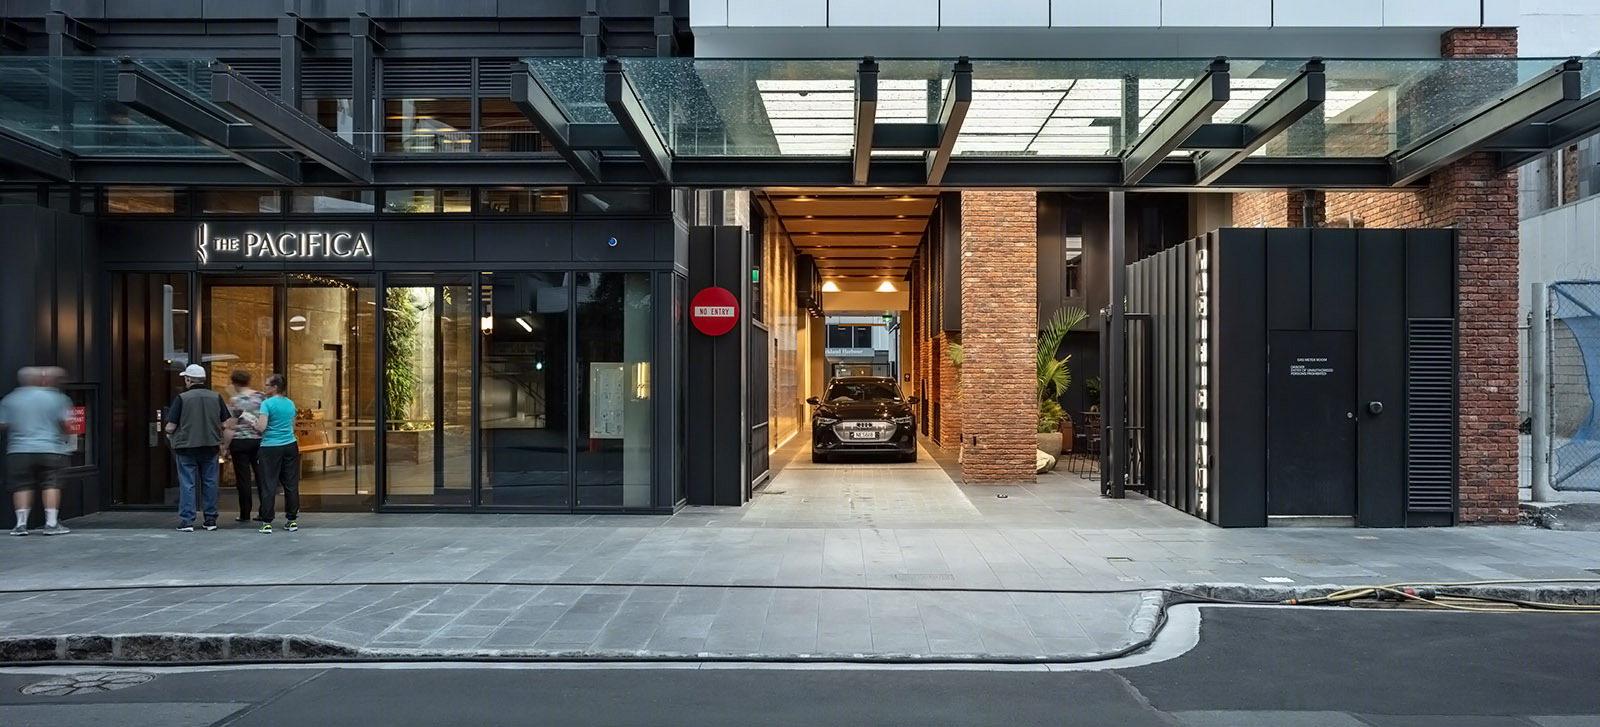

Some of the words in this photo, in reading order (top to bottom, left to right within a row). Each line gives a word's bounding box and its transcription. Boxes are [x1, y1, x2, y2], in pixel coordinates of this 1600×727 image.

[212, 237, 239, 251] THE
[244, 232, 372, 257] PACIFICA
[700, 308, 707, 316] NO
[711, 308, 730, 316] ENTRY
